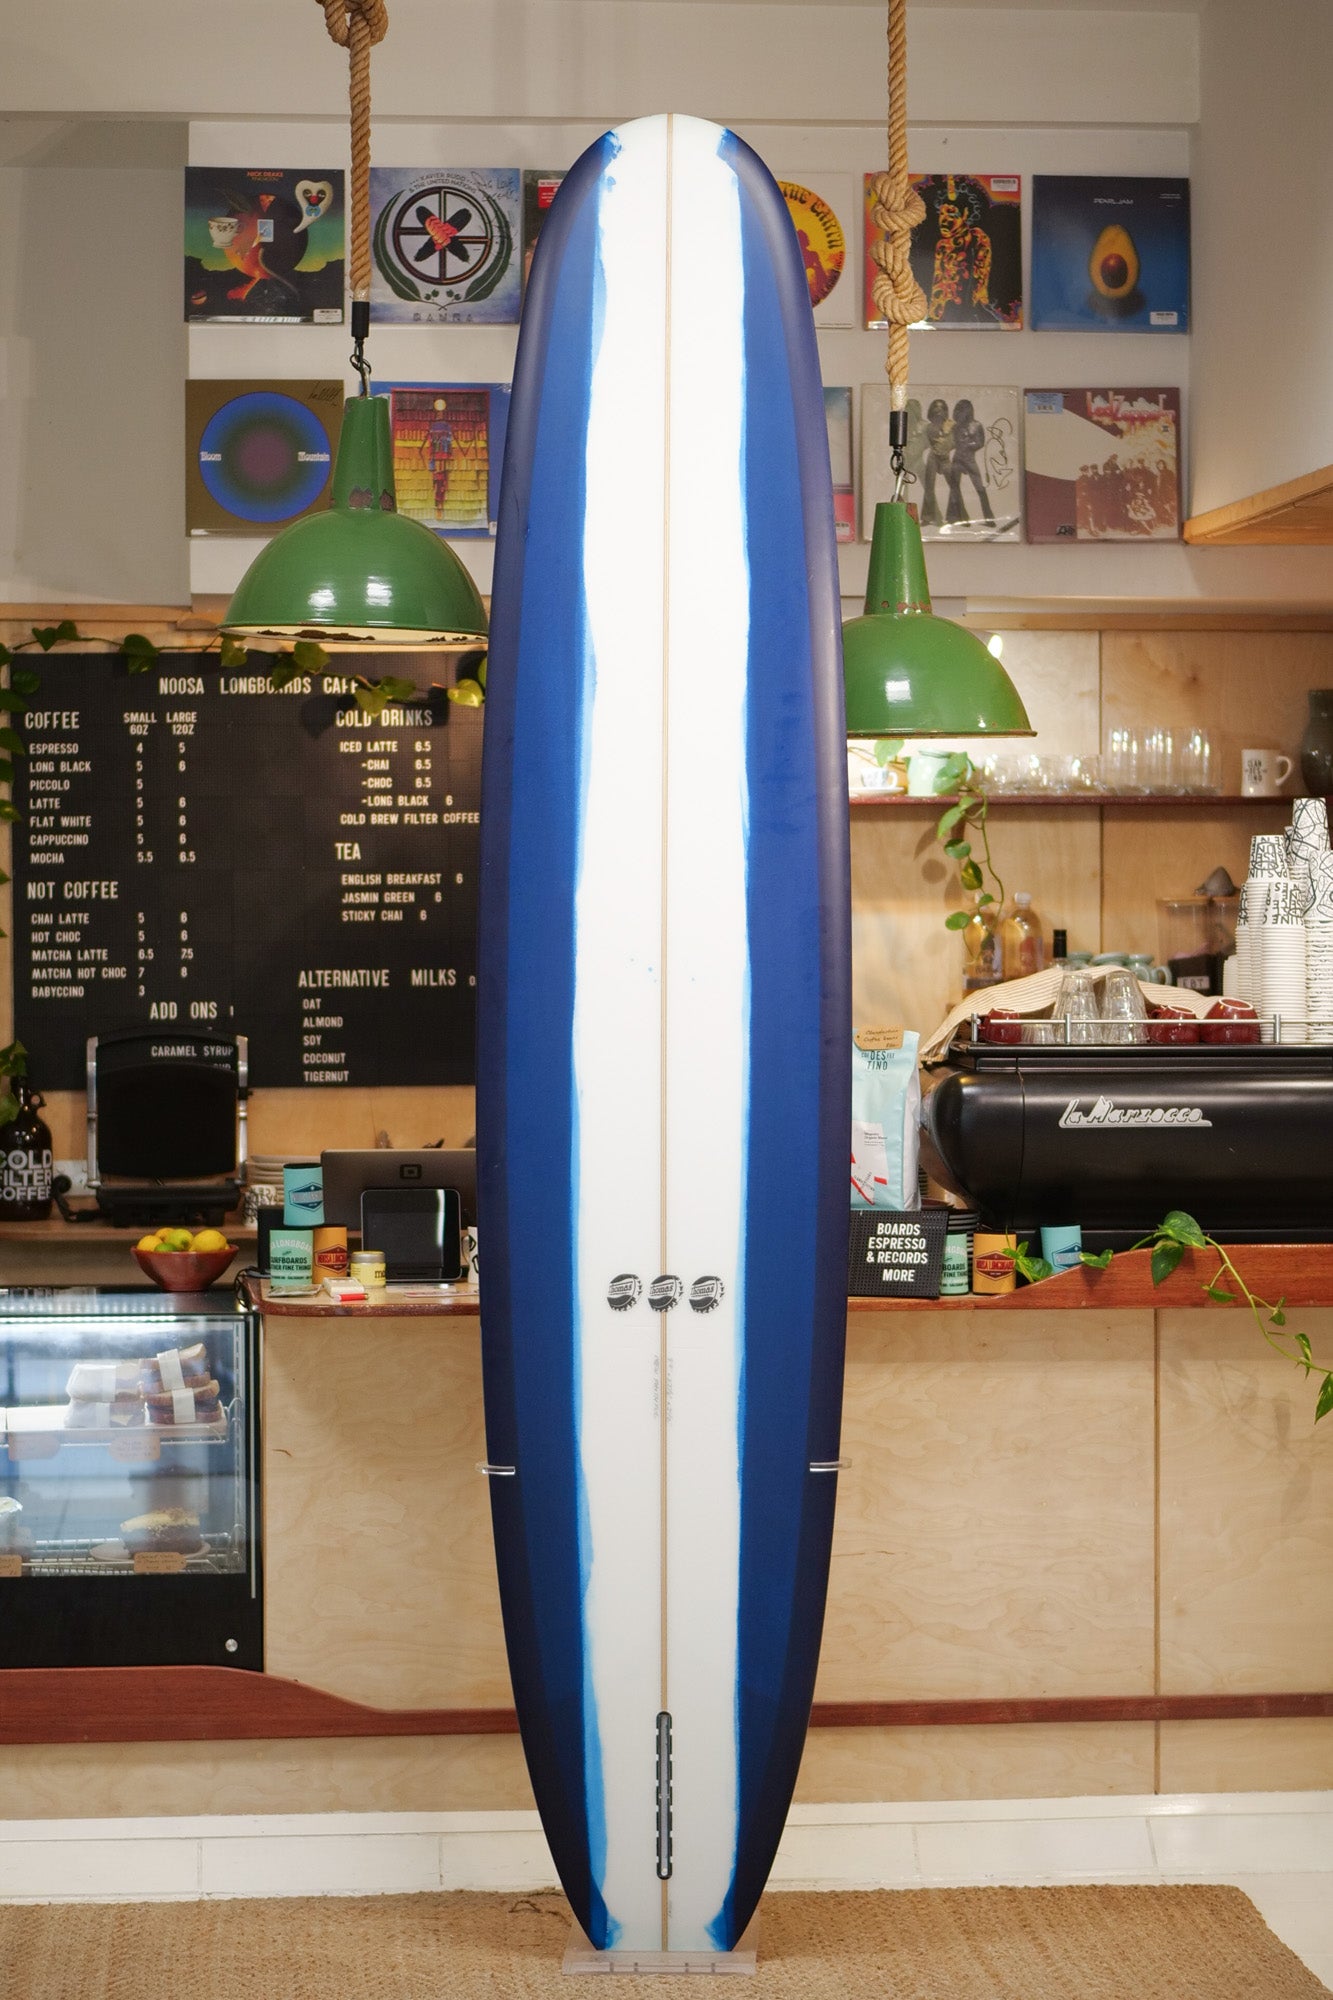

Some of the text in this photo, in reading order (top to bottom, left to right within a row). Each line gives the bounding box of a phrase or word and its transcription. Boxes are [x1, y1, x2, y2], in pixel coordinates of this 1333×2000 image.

[159, 678, 204, 694] NOOSA
[220, 677, 311, 694] LONGBORDS
[25, 712, 79, 729] COFFEE
[123, 712, 196, 723] SMALL LARGE
[336, 709, 433, 727] COLD DRINKS
[30, 742, 185, 754] ESPRESSO 4 5
[340, 741, 431, 752] ICED LATTE 6.5
[30, 760, 185, 772] LONG BLACK 5 6
[415, 759, 431, 770] 6.5
[30, 779, 143, 790] PICCOLO 5
[416, 777, 431, 788] 6.5
[30, 797, 186, 809] LATTE 5 6
[398, 795, 428, 806] BLACK
[446, 795, 453, 807] 6
[30, 815, 186, 827] FLAT WHITE 5 6
[340, 813, 479, 825] COLD BREW FILTER COFFEE
[30, 833, 186, 845] CAPPUCCINO 5 6
[31, 851, 195, 863] MOCHA 5.5 6.5
[335, 843, 361, 860] TEA
[342, 873, 463, 885] ENGLISH BREAKFAST 6
[28, 881, 118, 899] NOT COFFEE
[342, 892, 442, 903] JASMIN GREEN 6
[31, 912, 187, 924] CHAI LATTE 5 6
[342, 910, 427, 921] STICKY CHAI 6
[32, 930, 187, 942] HOT CHOC 5 6
[32, 948, 193, 961] MATCHA LATTE 6.5 7.5
[32, 967, 187, 979] MATCHA HOT CHOC 7 8
[299, 970, 389, 987] ALTERNATIVE
[412, 969, 456, 986] MILKS
[32, 985, 145, 997] BABYCCINO 3
[303, 998, 321, 1009] OAT
[150, 1002, 177, 1019] ADD
[191, 1002, 217, 1018] ONS
[303, 1017, 343, 1027] ALMOND
[303, 1035, 321, 1046] SOY
[151, 1046, 233, 1056] CARAMEL SYRUP
[870, 1050, 886, 1060] DES
[303, 1053, 345, 1064] COCONUT
[867, 1061, 888, 1070] TINO
[304, 1071, 348, 1082] TIGERNUT
[1086, 1096, 1206, 1125] Marzocco
[0, 1170, 52, 1186] ILTER
[0, 1186, 51, 1200] OFFE
[877, 1223, 921, 1236] BOARDS
[868, 1237, 926, 1250] ESPRESSO
[866, 1251, 928, 1264] & RECORDS
[882, 1269, 915, 1281] MORE
